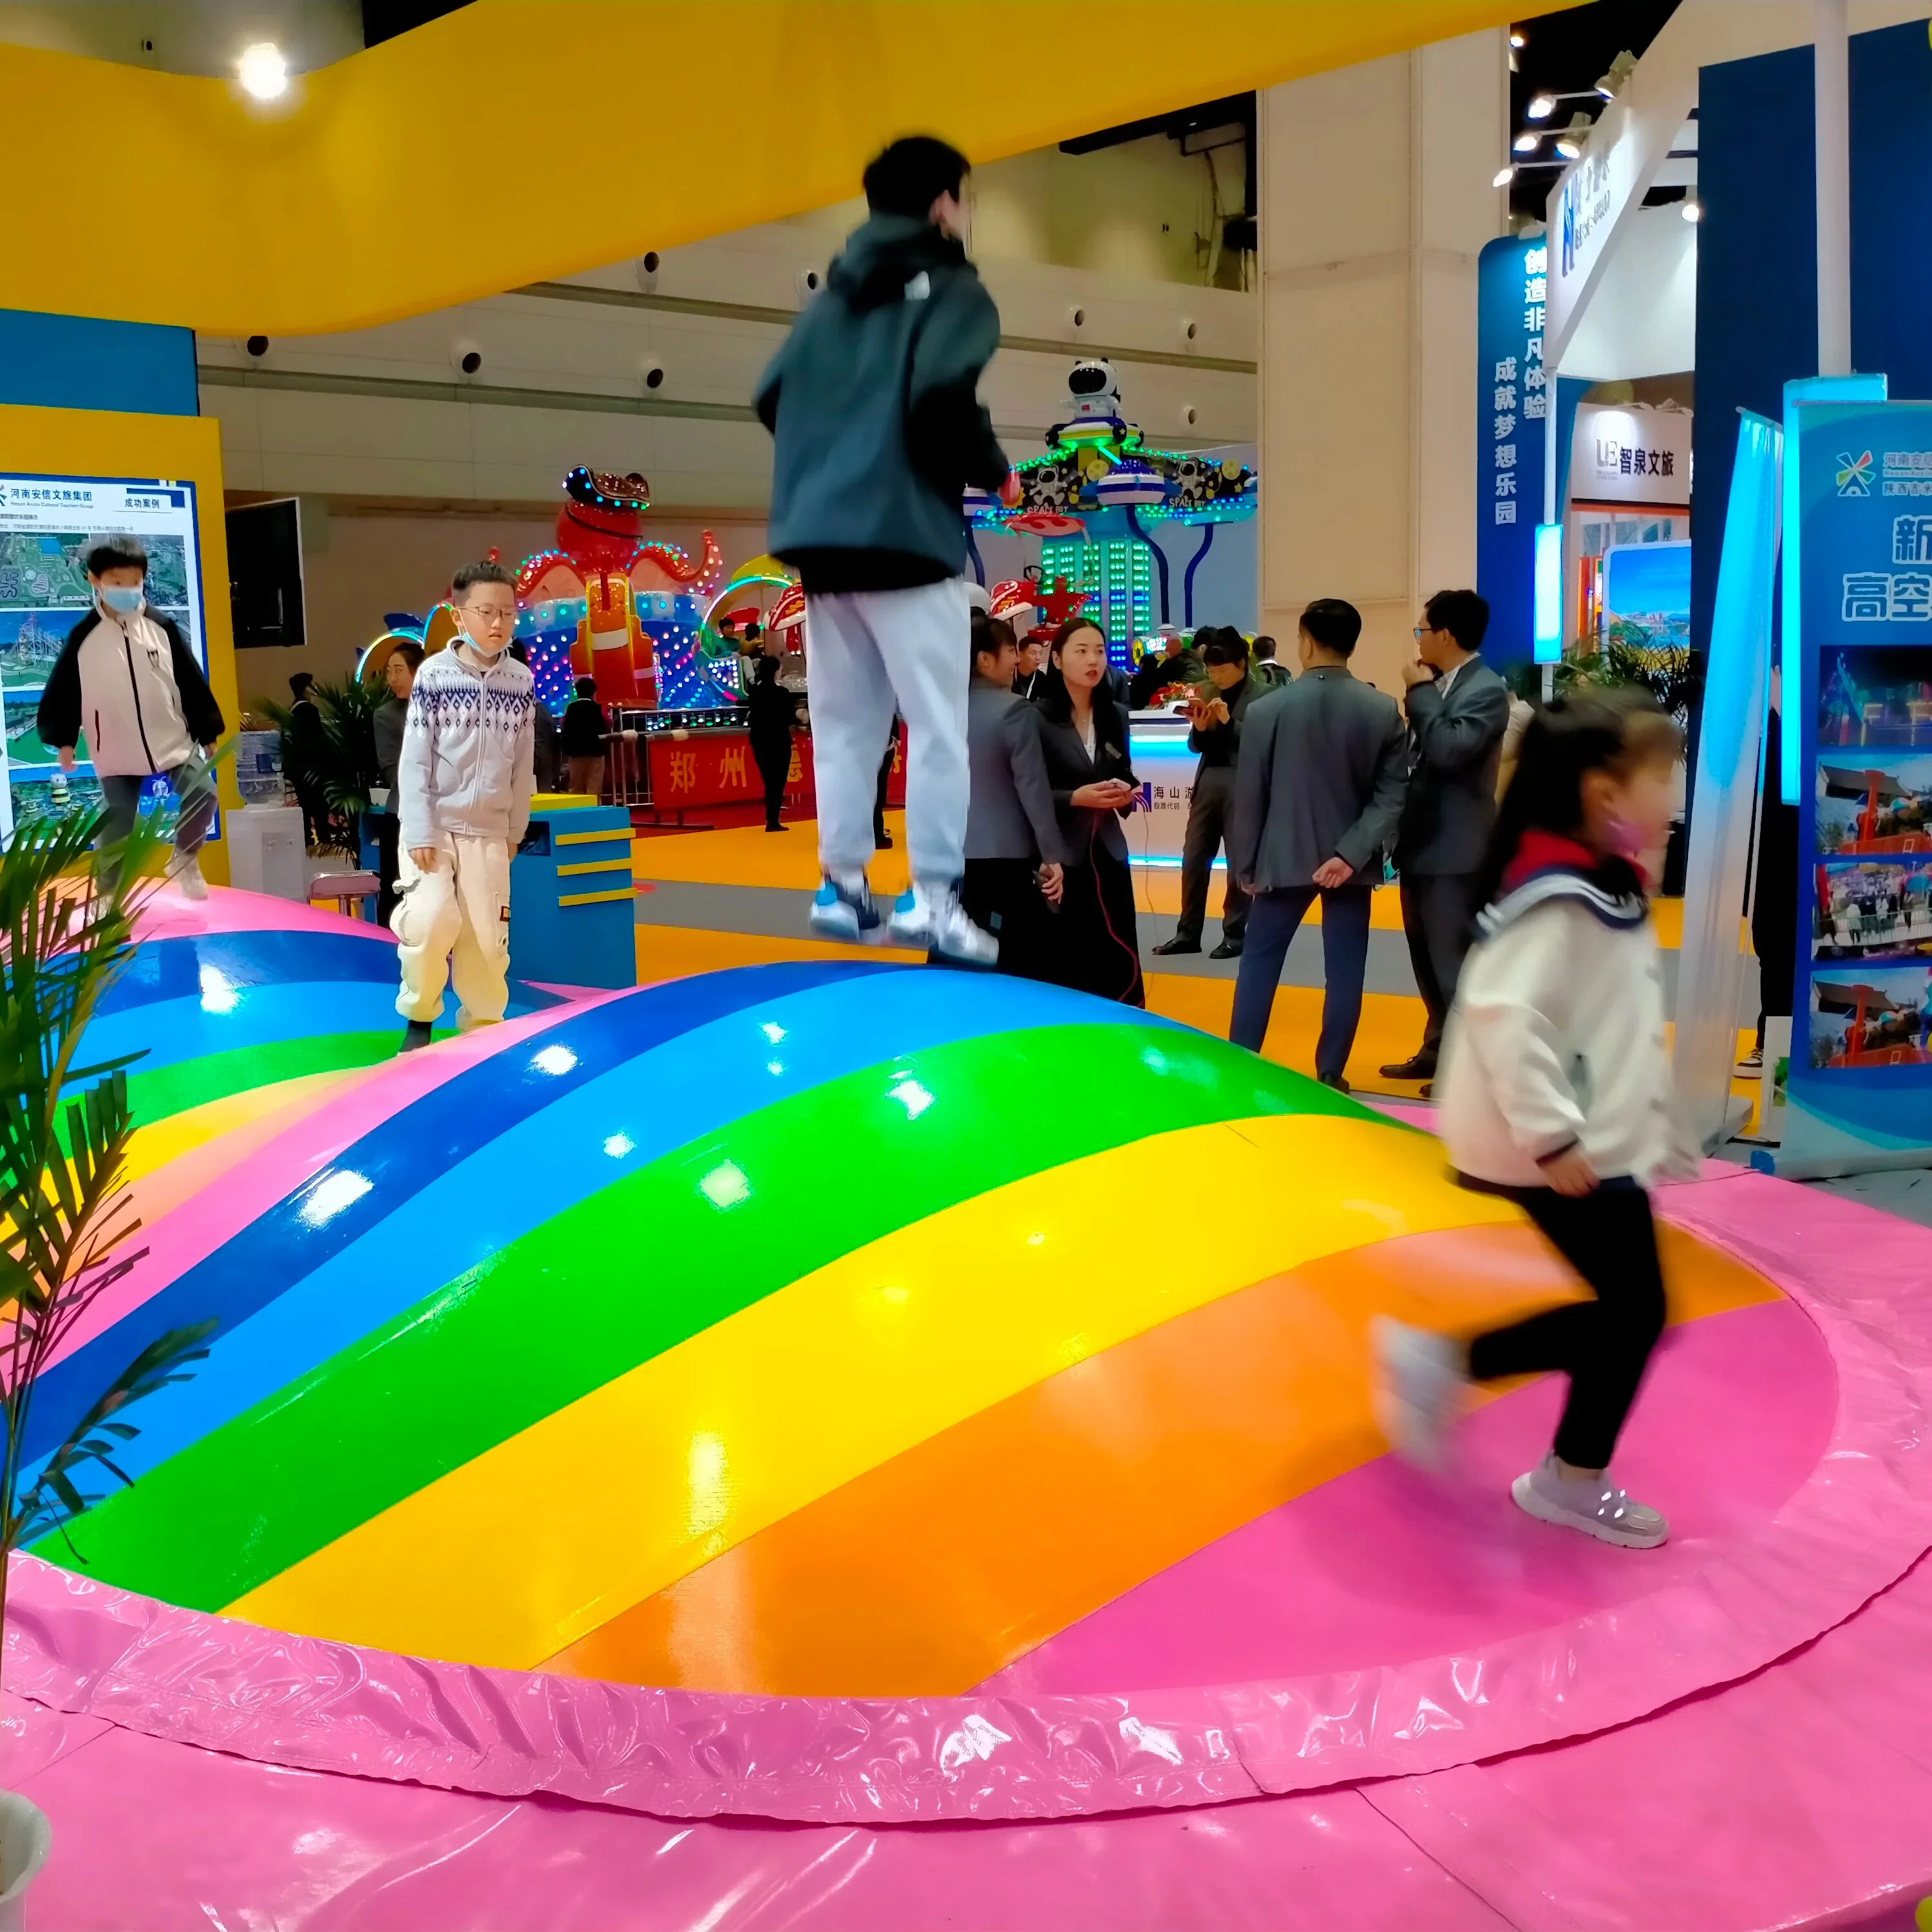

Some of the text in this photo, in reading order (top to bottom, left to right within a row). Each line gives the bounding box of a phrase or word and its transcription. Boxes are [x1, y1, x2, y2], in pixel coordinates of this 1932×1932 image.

[1494, 356, 1517, 525] 成就梦想乐园
[10, 488, 92, 502] 河南安信文旅集团
[125, 498, 160, 509] 成功案例
[1842, 572, 1931, 621] 高空
